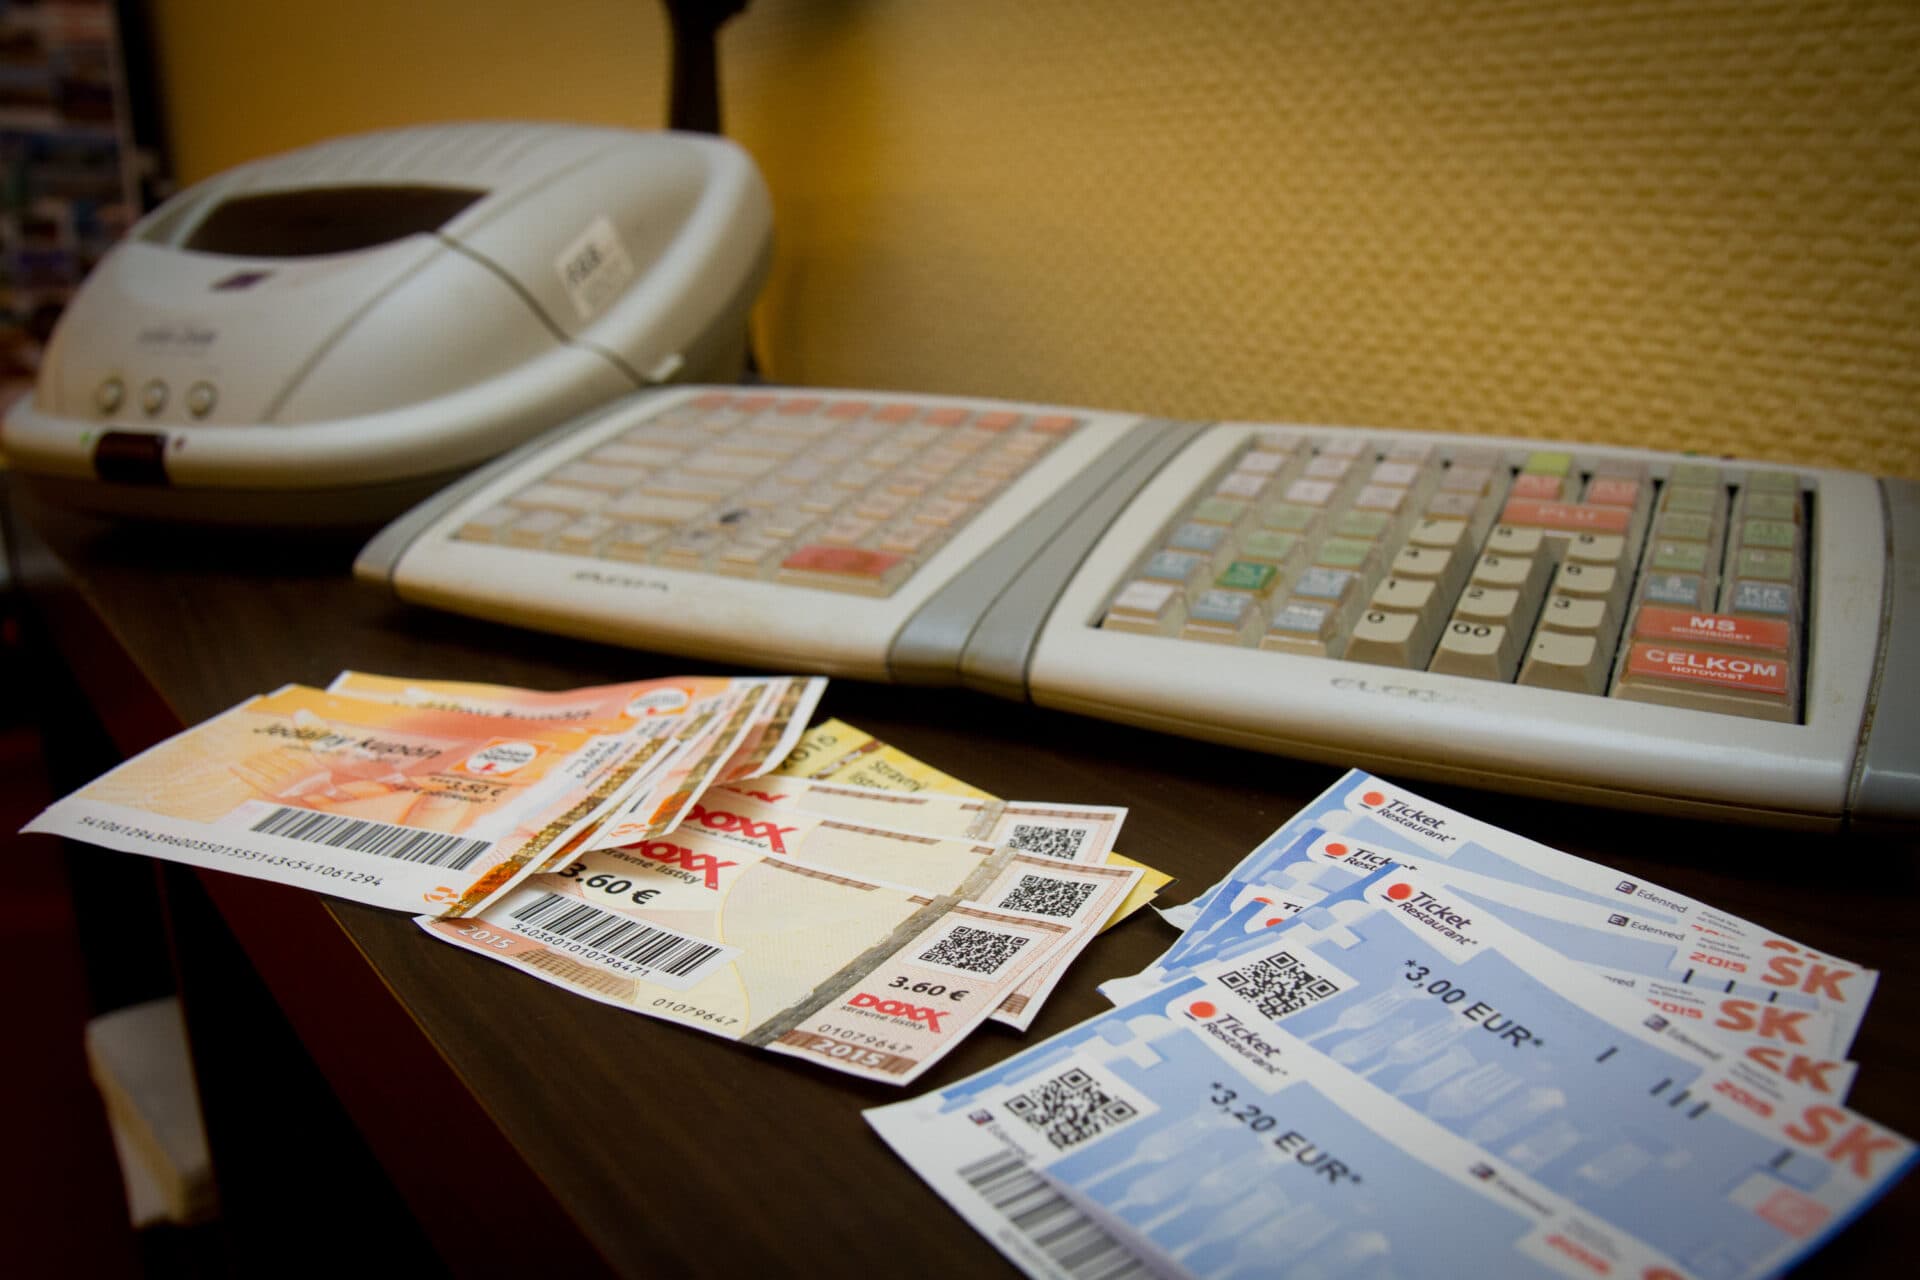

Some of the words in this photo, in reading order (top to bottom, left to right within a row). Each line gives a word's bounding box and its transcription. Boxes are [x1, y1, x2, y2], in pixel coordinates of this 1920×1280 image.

[1452, 622, 1492, 638] 00
[1689, 615, 1737, 632] MS
[1645, 648, 1778, 678] CELKOM
[1670, 664, 1745, 682] HOTOVOST
[1386, 798, 1449, 831] Ticket
[557, 862, 633, 895] 3.60
[631, 888, 662, 906] €
[1410, 890, 1473, 932] Ticket
[1636, 888, 1689, 914] Edenred
[458, 924, 515, 950] 2015
[1630, 920, 1686, 942] Edenred
[1689, 951, 1748, 974] 2015
[887, 975, 947, 997] 3.60
[949, 989, 970, 1002] €
[1760, 954, 1856, 1004] SK
[652, 997, 739, 1027] 01079647
[847, 992, 950, 1034] DOXX
[1714, 998, 1814, 1046] SK
[817, 1023, 913, 1053] 01079647
[1214, 1012, 1281, 1058] Ticket
[810, 1038, 887, 1068] 2015
[1782, 1103, 1902, 1181] SK
